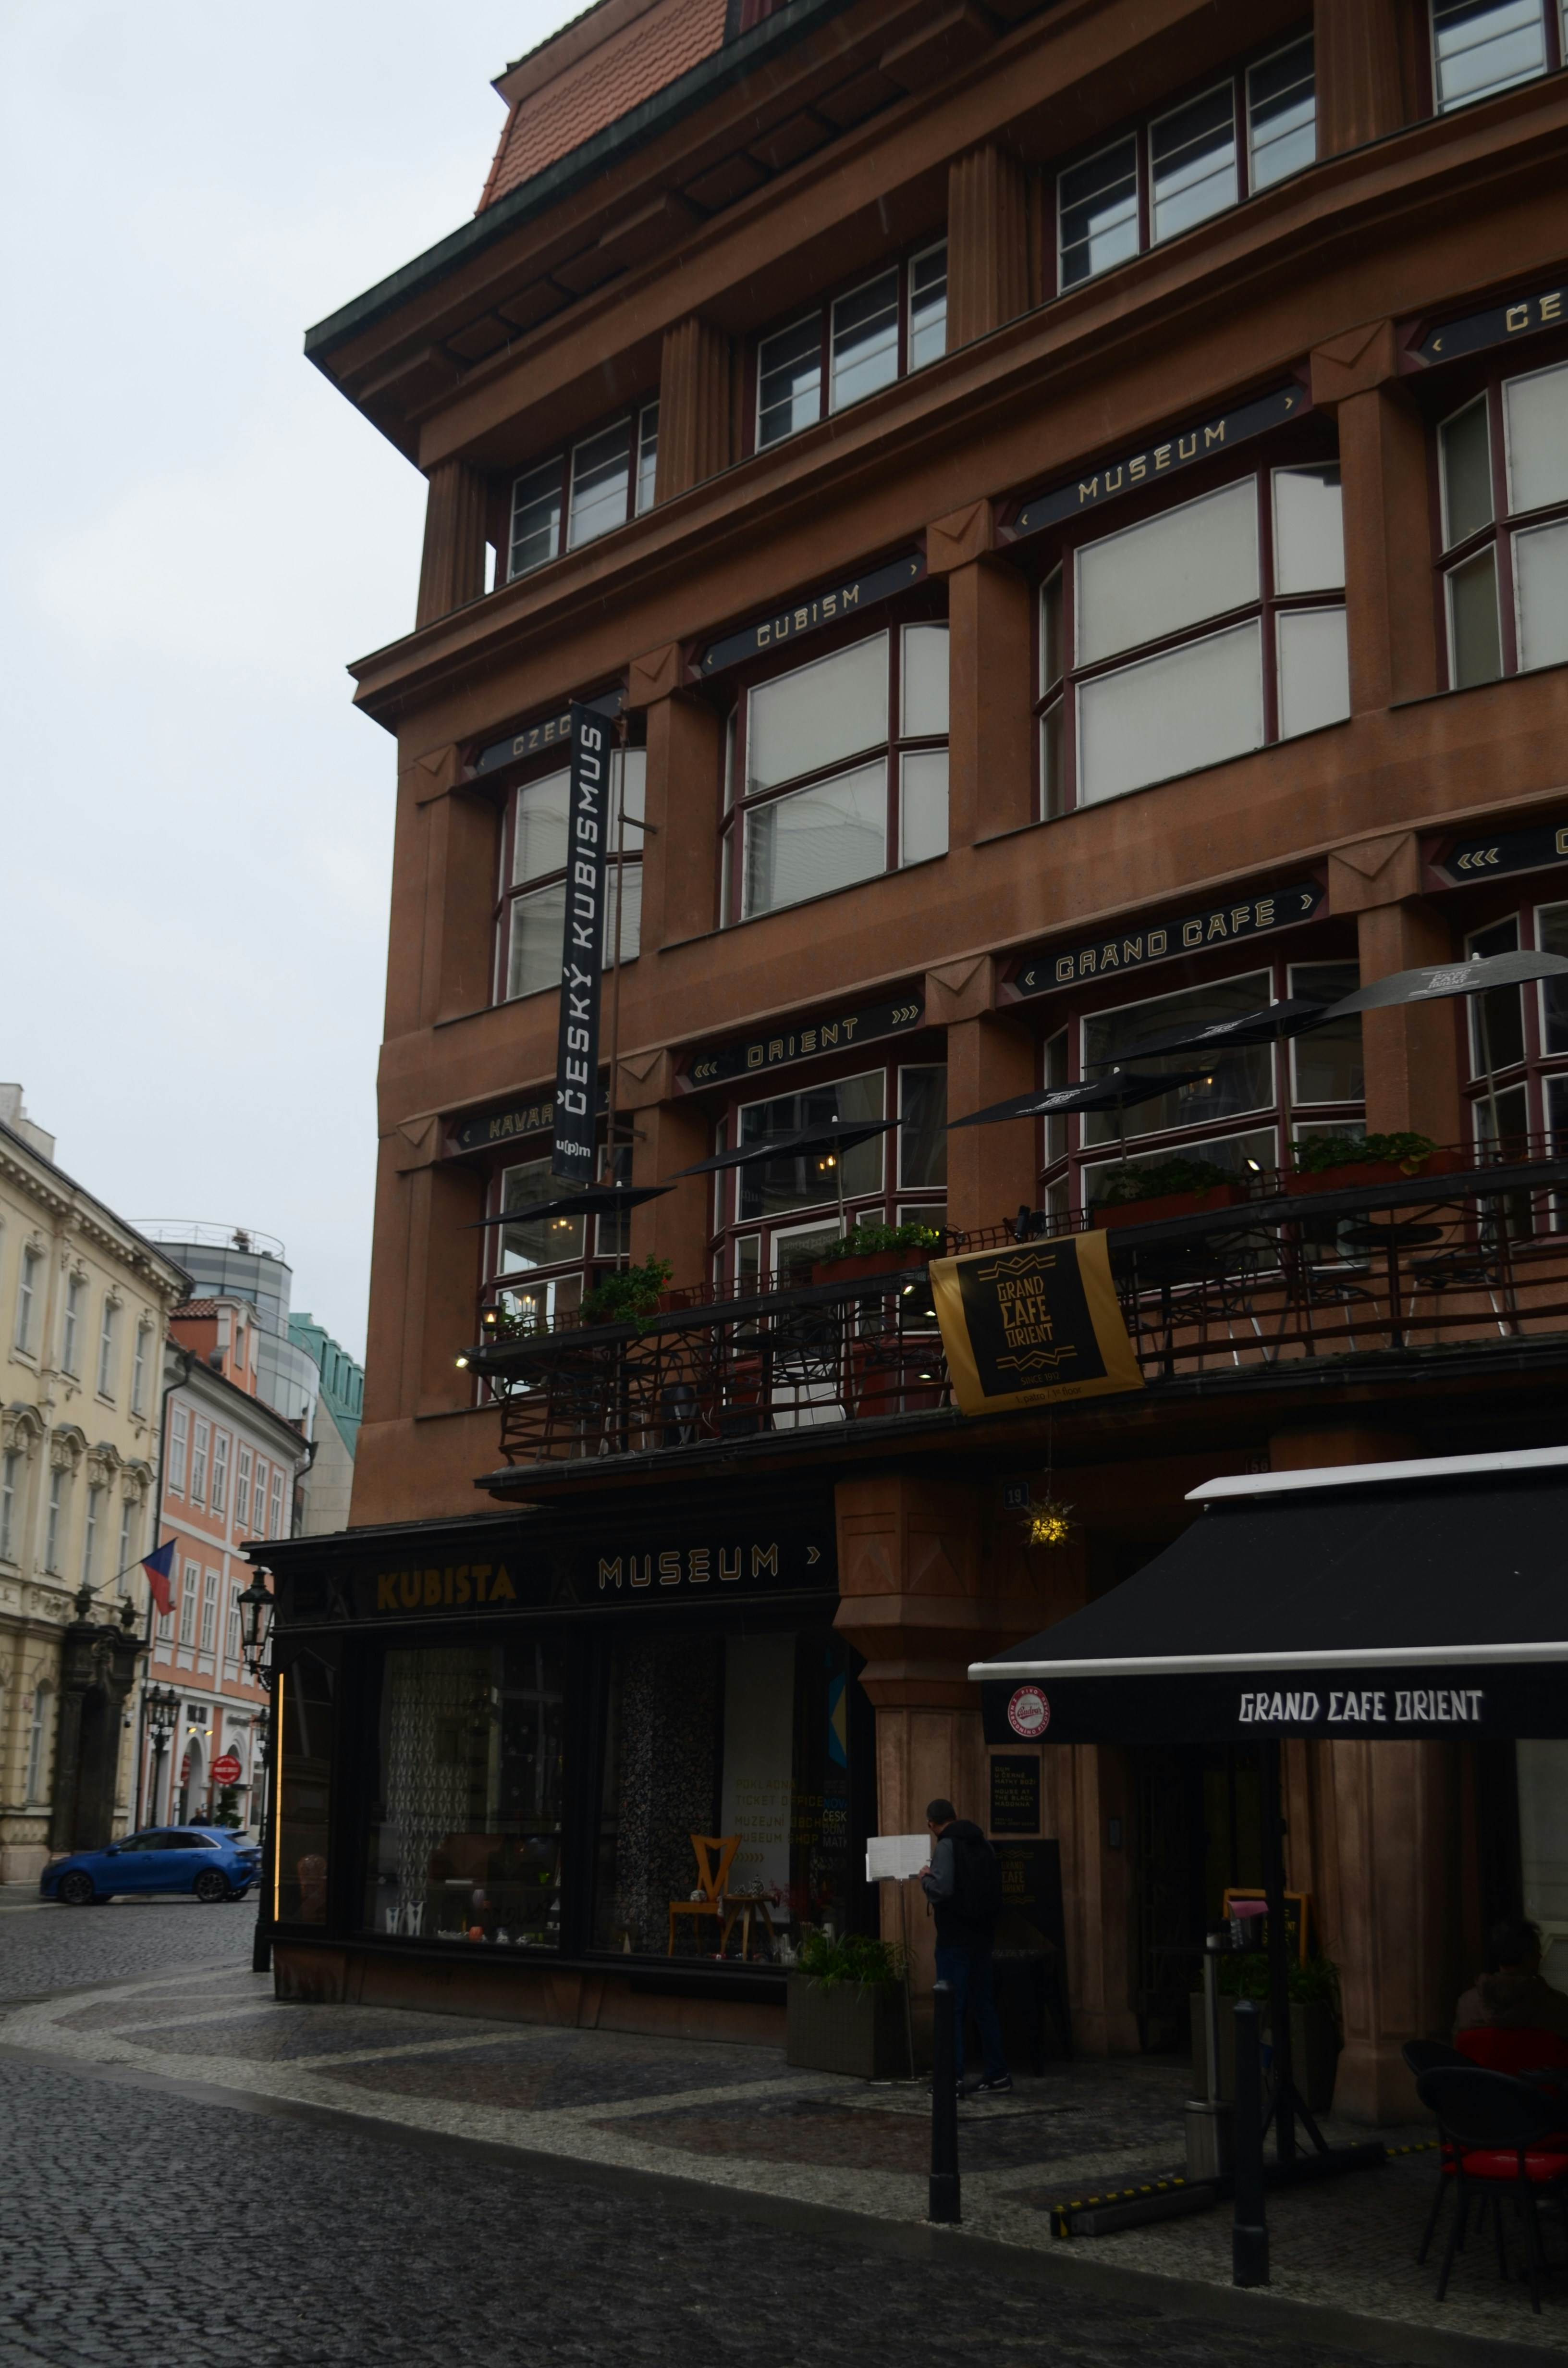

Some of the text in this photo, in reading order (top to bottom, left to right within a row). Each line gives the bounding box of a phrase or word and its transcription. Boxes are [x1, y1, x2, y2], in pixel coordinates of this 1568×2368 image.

[1078, 420, 1225, 503] MUSEUM
[757, 584, 859, 647] CUBISM
[513, 714, 572, 755] CZEC
[557, 724, 601, 1116] ČESKÝ KUBISMUS
[1056, 899, 1275, 982] GRAND CAFE
[747, 1017, 858, 1067] ORIENT
[556, 1139, 591, 1158] u(p)m
[996, 1275, 1044, 1301] GRAND
[1000, 1295, 1051, 1329] CAFE
[1005, 1322, 1053, 1348] ORIENT
[1020, 1371, 1061, 1385] SINCE 1912
[1023, 1393, 1045, 1404] patro
[1062, 1387, 1081, 1396] floor
[1008, 1489, 1022, 1504] 19
[598, 1542, 779, 1590] MUSEUM
[377, 1563, 517, 1610] KUBISTA
[1238, 1690, 1483, 1722] GRAND CAFE ORIENT
[735, 1779, 797, 1789] POKLADNA
[736, 1795, 823, 1807] TICKET OFFICE
[735, 1813, 784, 1826] MUZEJNÍ
[735, 1832, 819, 1845] MUSEUM SHOP
[1001, 1871, 1026, 1883] CAFE
